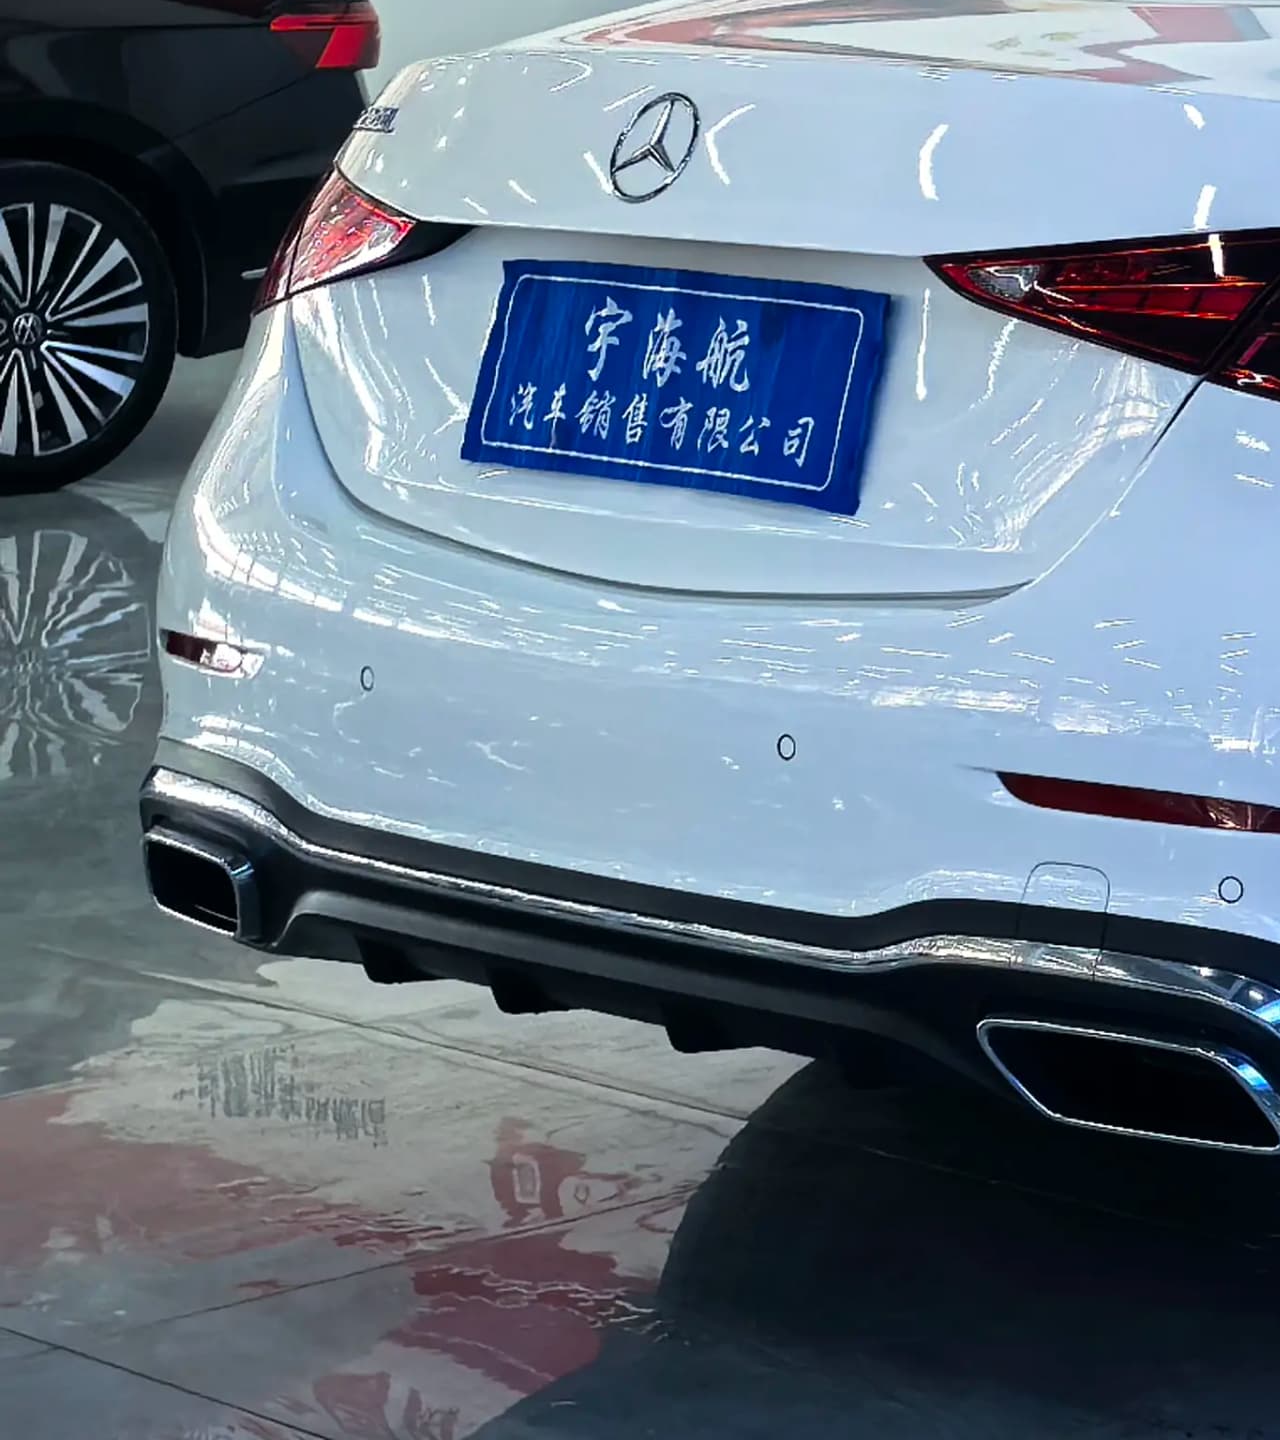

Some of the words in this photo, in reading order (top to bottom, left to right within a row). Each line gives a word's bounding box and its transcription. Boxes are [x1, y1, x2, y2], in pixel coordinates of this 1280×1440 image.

[583, 296, 754, 392] 宇海航
[508, 383, 816, 469] 汽车销售有限公司
